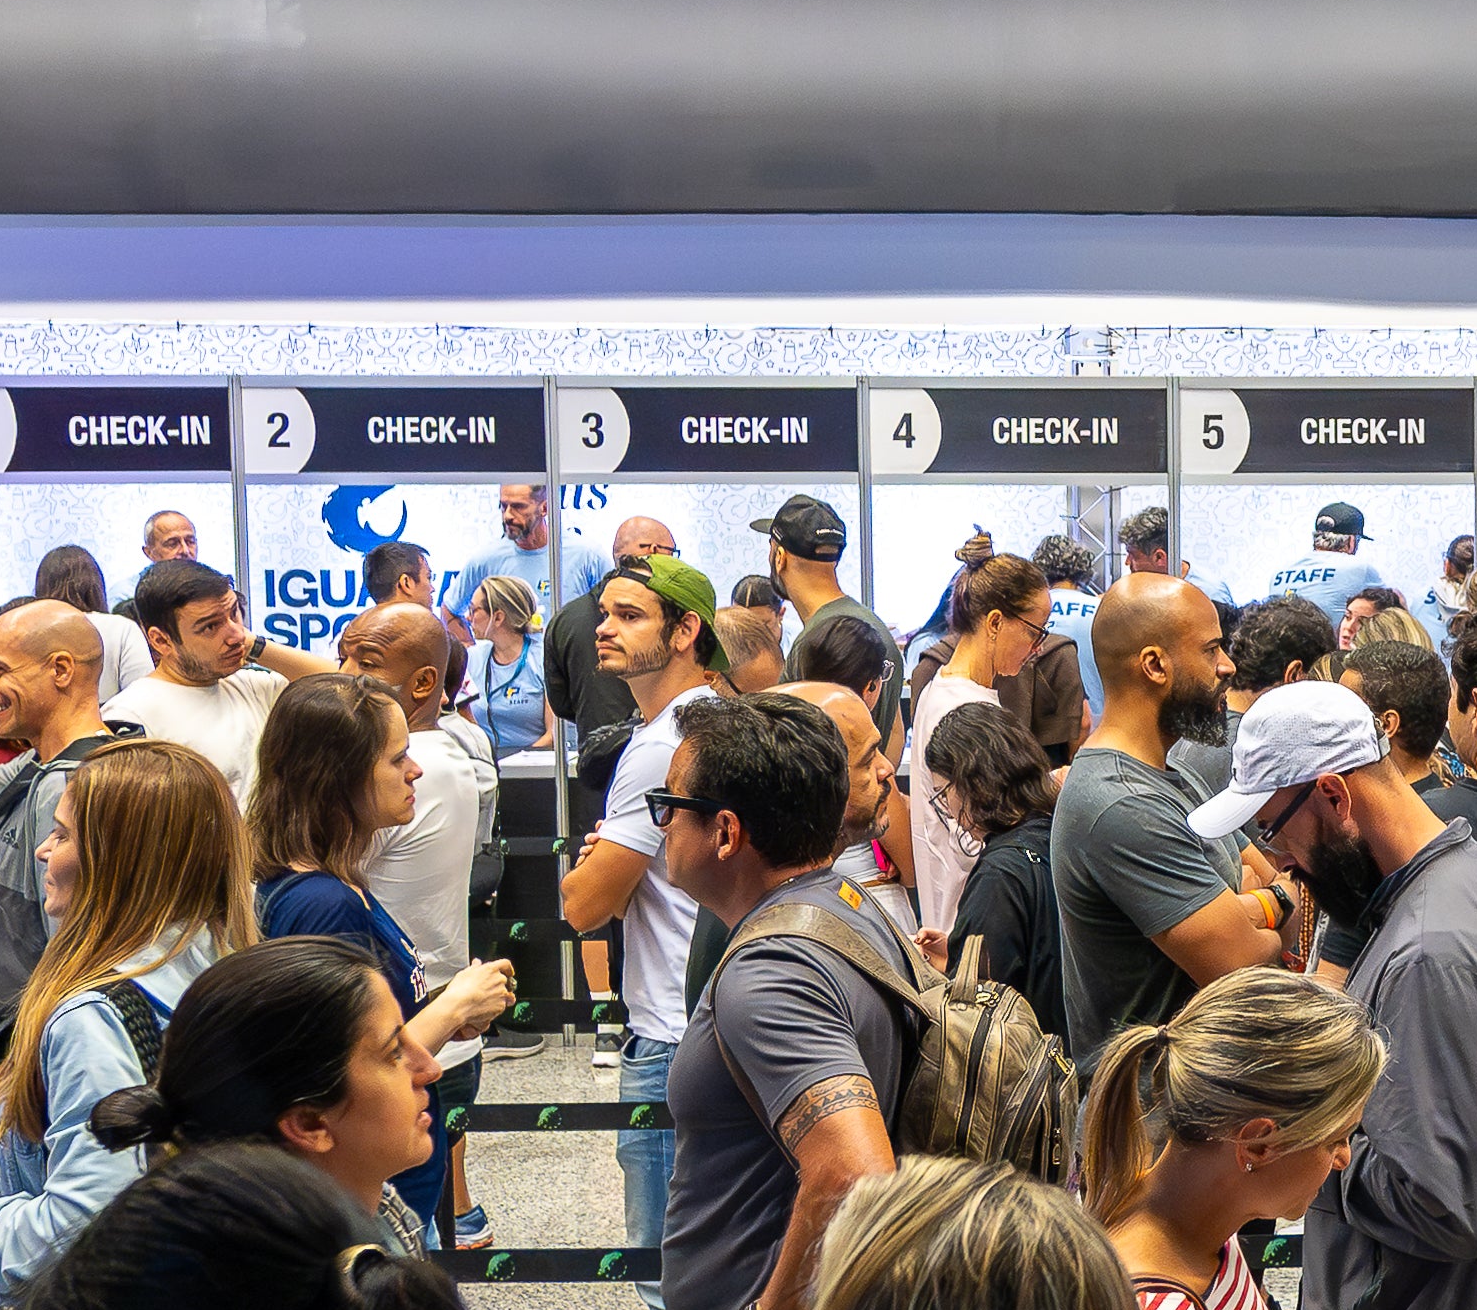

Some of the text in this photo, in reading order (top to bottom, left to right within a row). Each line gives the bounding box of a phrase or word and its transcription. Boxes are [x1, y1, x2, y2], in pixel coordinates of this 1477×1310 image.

[68, 415, 211, 446] CHECK-IN
[267, 412, 496, 448] 2 CHECK-IN
[581, 412, 808, 449] 3 CHECK-IN
[892, 412, 1118, 449] 4 CHECK-IN
[1202, 414, 1425, 450] 5 CHECK-IN
[1274, 568, 1336, 586] STAFF
